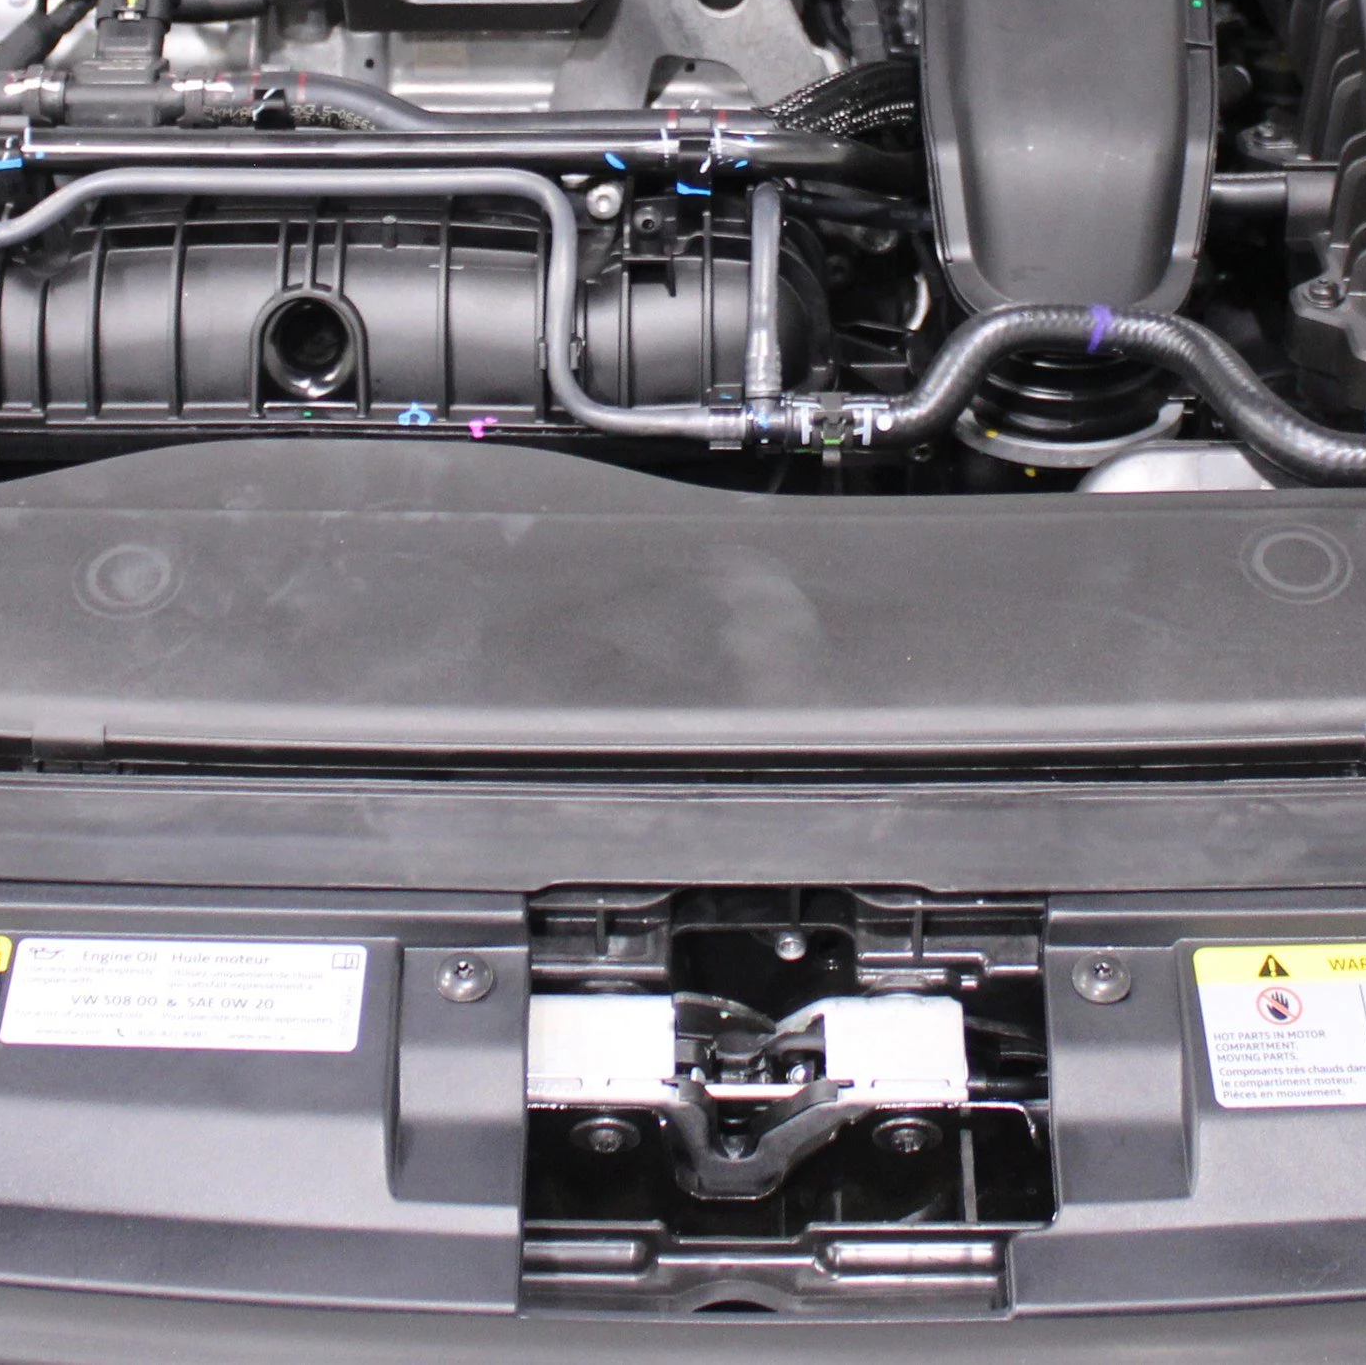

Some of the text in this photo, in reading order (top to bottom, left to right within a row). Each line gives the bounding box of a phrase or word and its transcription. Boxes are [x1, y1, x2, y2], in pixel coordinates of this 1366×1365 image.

[81, 950, 157, 964] Engine Oil
[171, 952, 269, 964] Huile moteur
[70, 994, 98, 1005] VW
[103, 995, 132, 1005] 508
[136, 995, 158, 1006] 00
[1213, 1030, 1326, 1040] HOT PARTS IN MOTOR
[1214, 1041, 1298, 1051] COMPARTMENT.
[1216, 1052, 1298, 1062] MOVING PARTS.
[1218, 1066, 1283, 1077] Composants
[1285, 1065, 1305, 1074] très
[1306, 1064, 1344, 1073] chauds
[1220, 1076, 1356, 1089] le compartiment moteur.
[1222, 1088, 1346, 1099] Pièces en mouvement.
